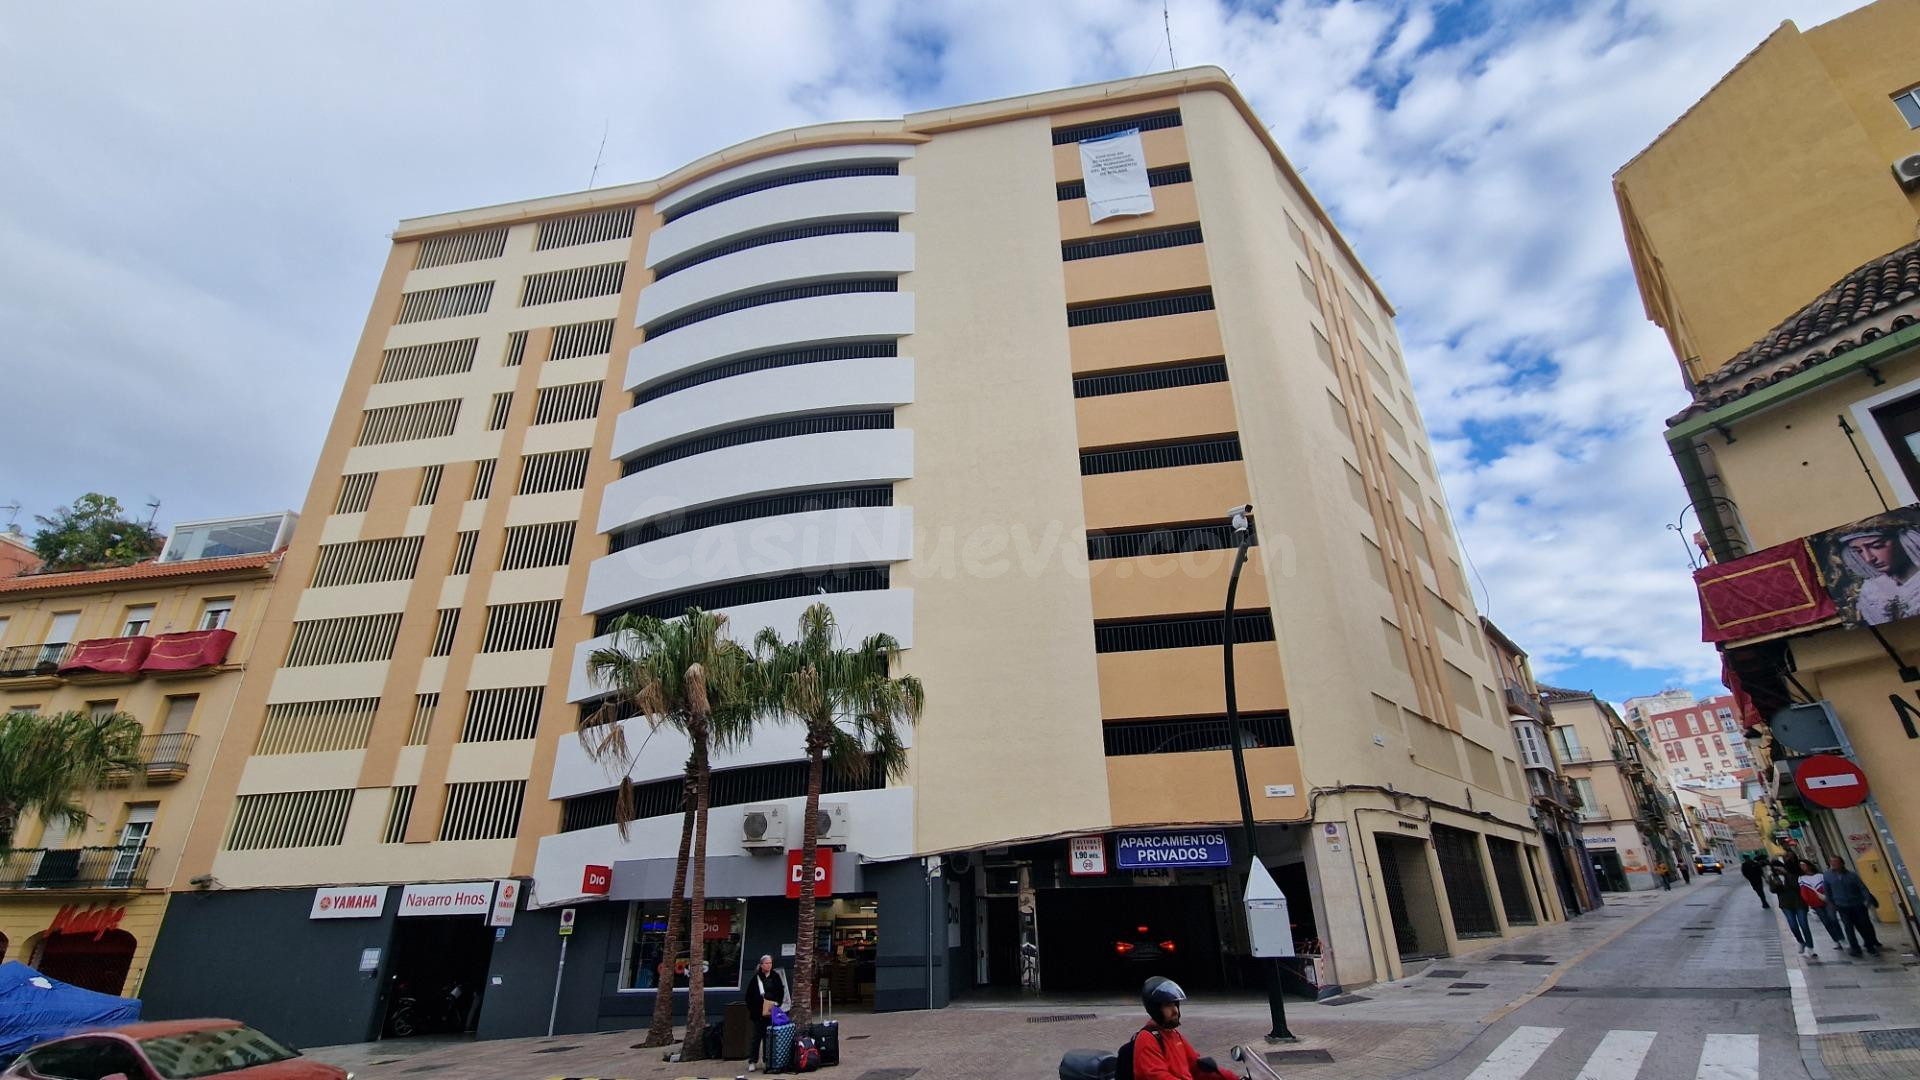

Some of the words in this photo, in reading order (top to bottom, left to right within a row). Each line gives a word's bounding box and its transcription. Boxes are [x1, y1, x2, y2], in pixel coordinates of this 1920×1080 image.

[1120, 834, 1224, 849] APARCAMIENTOS
[1137, 847, 1208, 862] PRIVADOS
[791, 864, 826, 882] Da
[333, 894, 378, 910] YAMAHA
[405, 893, 452, 908] Navarro
[454, 891, 488, 906] Hnos.
